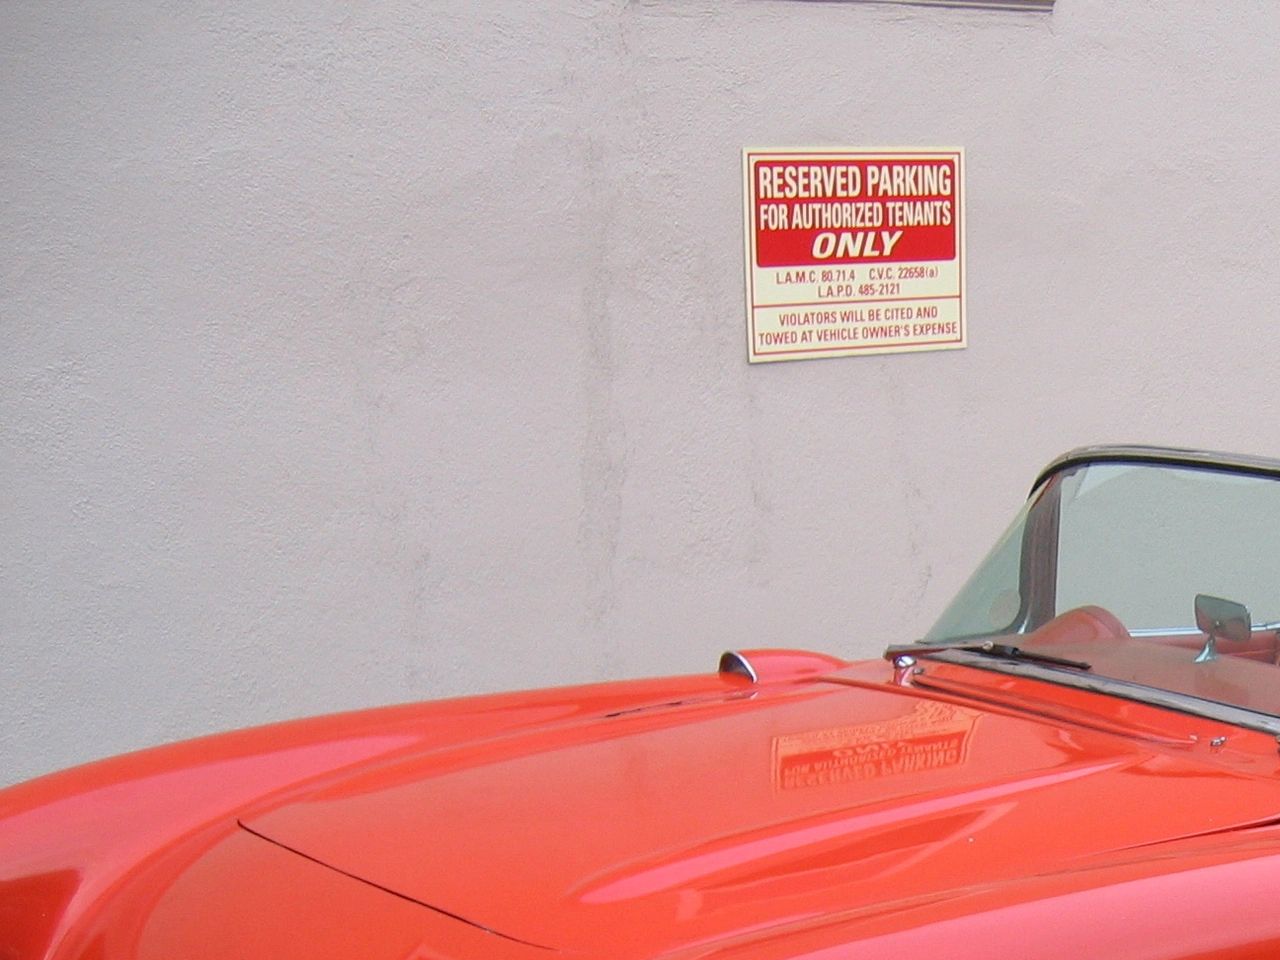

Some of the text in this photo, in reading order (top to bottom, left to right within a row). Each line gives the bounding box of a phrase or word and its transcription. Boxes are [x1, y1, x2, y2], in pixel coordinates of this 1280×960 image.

[759, 164, 951, 199] RESERVED PARKING
[760, 200, 951, 230] FOR AUTHORIZED TENANTS
[812, 231, 903, 258] ONLY
[776, 266, 939, 285] L.A.M.C. 80.71.4 C.V.C. 22658(a)
[818, 283, 900, 298] L.A.P.D. 485-2121
[779, 306, 938, 326] VIOLATORS WILL BE CITED AND
[759, 321, 958, 346] TOWED AT VEHICLE OWNER'S EXPENSE
